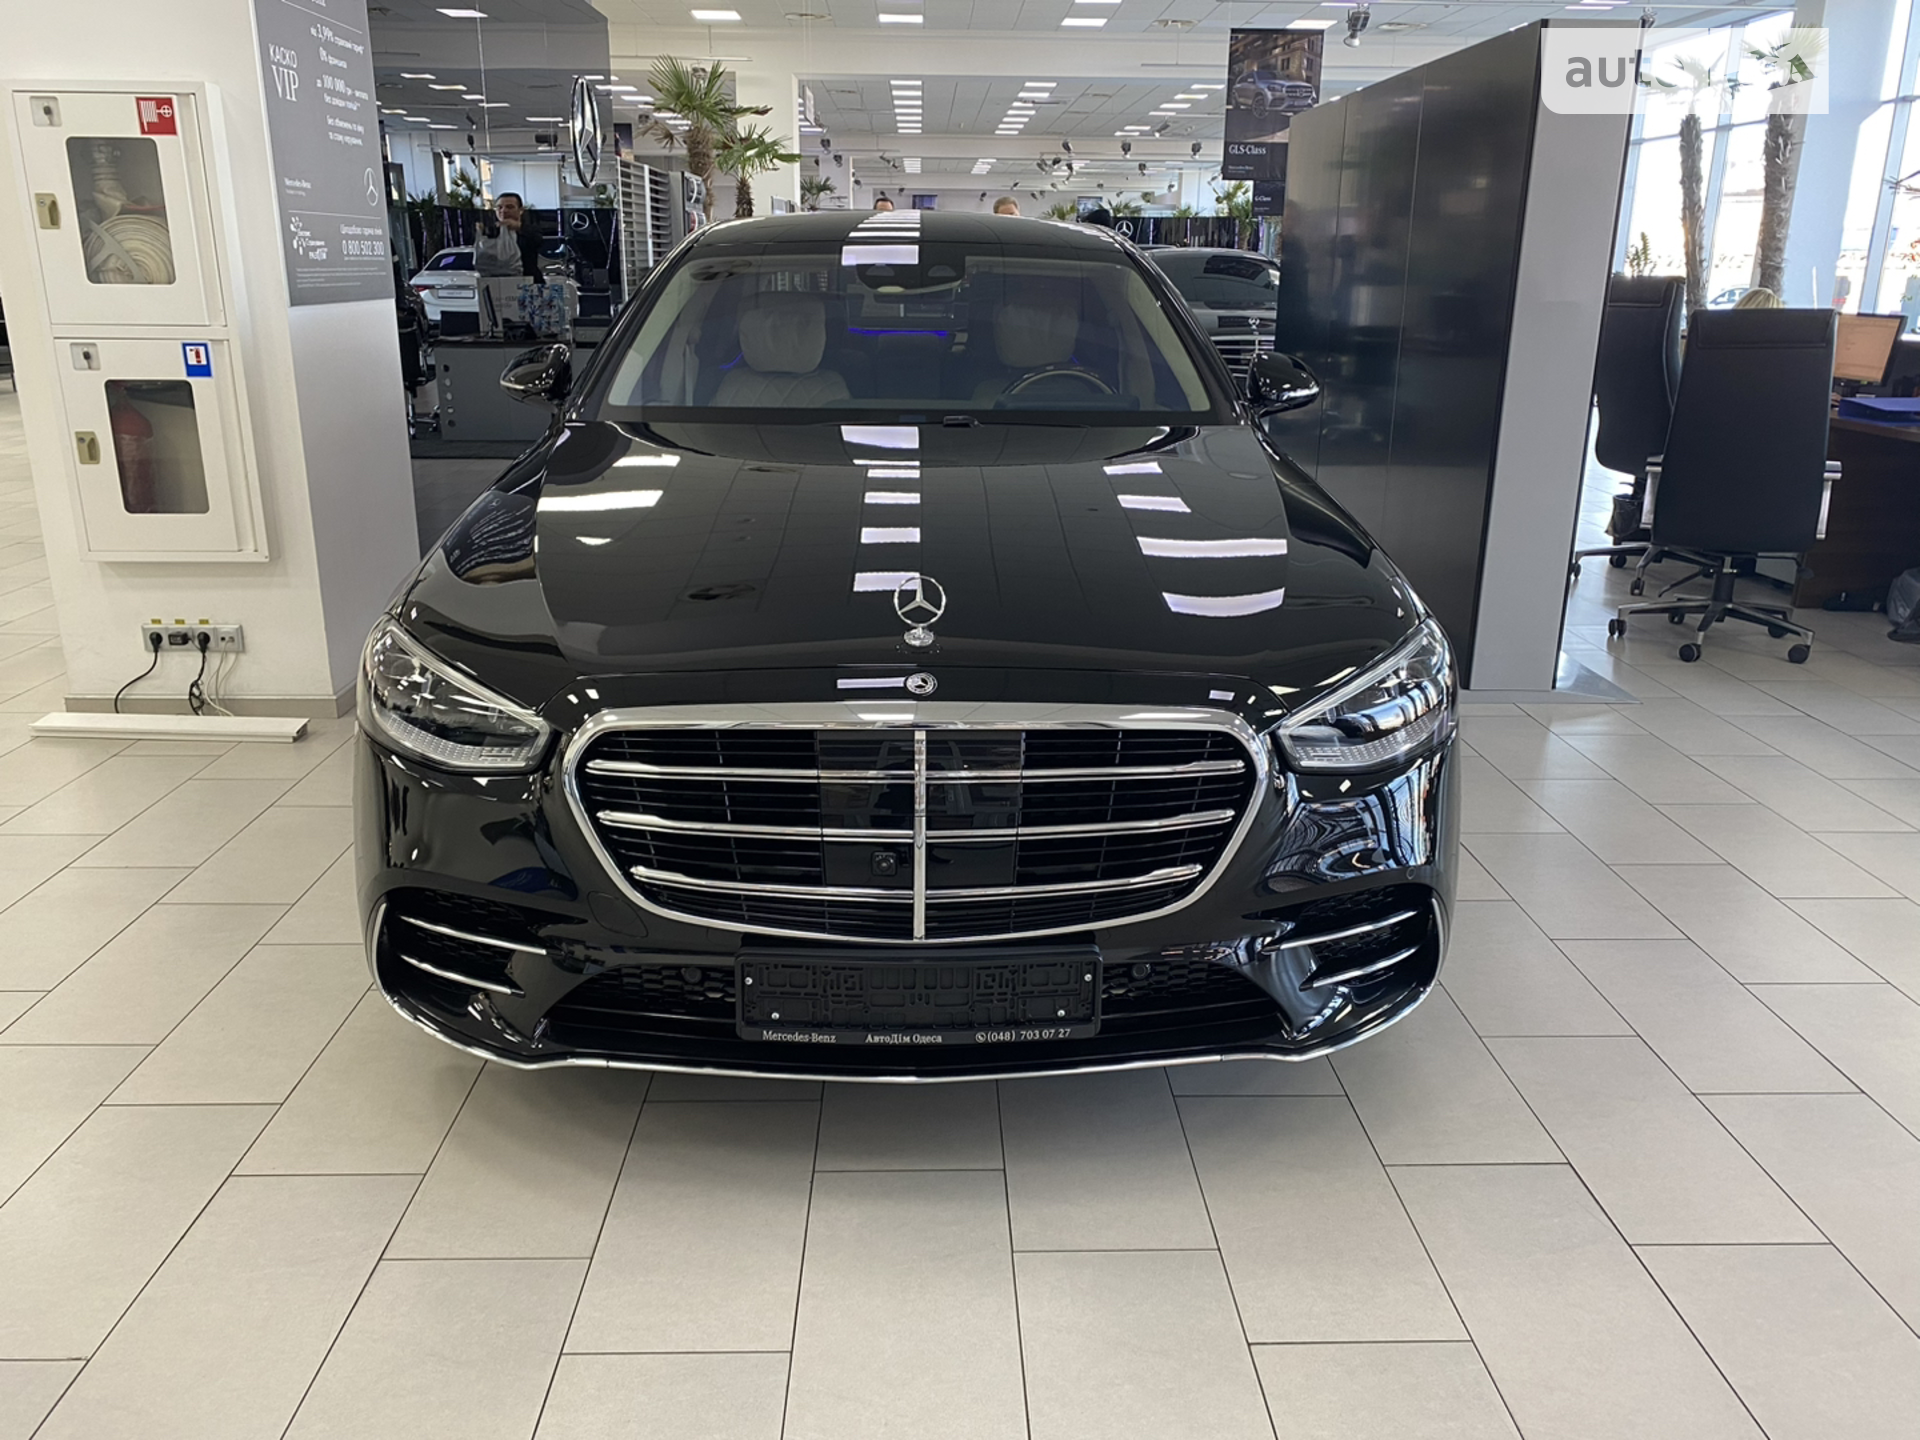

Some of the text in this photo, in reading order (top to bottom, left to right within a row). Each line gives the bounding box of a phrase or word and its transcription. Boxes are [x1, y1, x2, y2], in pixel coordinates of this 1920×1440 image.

[268, 43, 298, 69] КАСКО
[271, 64, 298, 102] VIP
[322, 74, 334, 90] 100
[334, 77, 345, 94] 000
[1228, 144, 1267, 155] GLS-Class
[342, 239, 384, 255] 0 800 502 300
[762, 1030, 837, 1043] Mercedes-Benz
[865, 1033, 942, 1045] АвтоДім Одеса
[987, 1028, 1071, 1042] (048) 703 07 27
